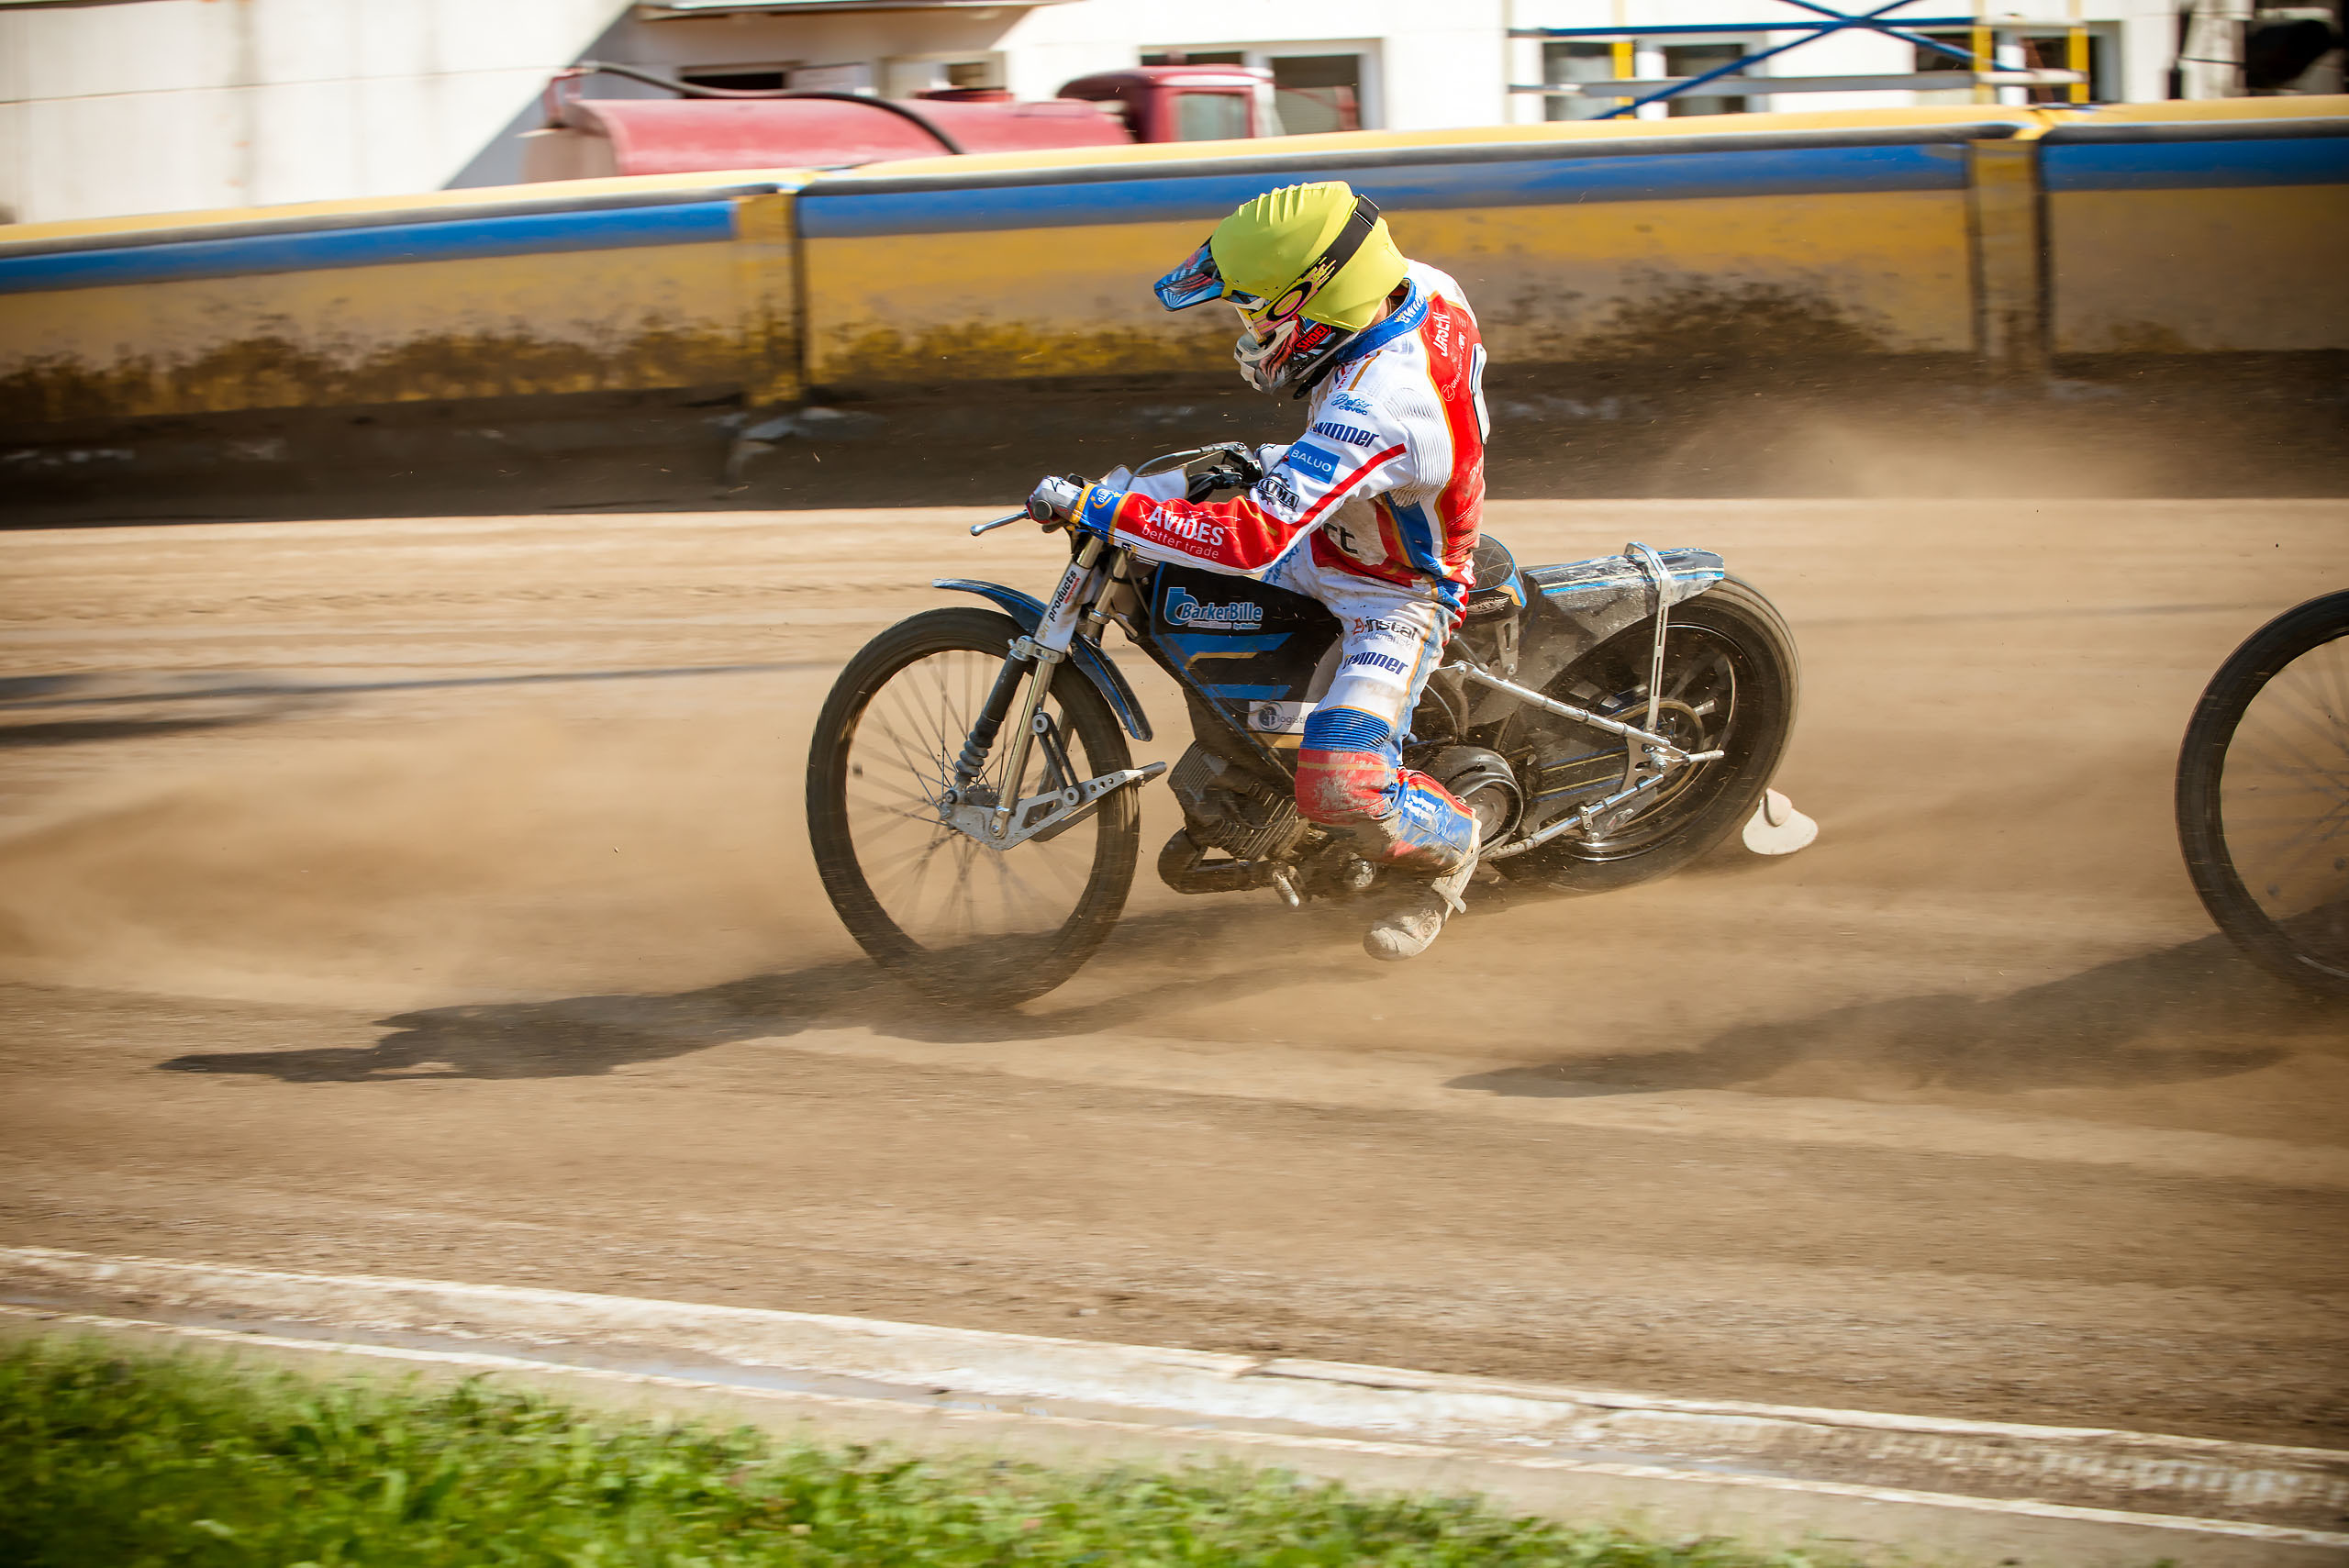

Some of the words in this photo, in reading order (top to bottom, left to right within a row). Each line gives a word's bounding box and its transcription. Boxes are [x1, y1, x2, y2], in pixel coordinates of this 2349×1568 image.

[1296, 325, 1329, 350] SHOEI
[1290, 449, 1332, 473] BALUO
[1147, 505, 1224, 546] AVIDES
[1141, 524, 1181, 548] better
[1185, 541, 1219, 559] trade
[1048, 570, 1077, 622] products
[1180, 602, 1264, 622] BarkerBille
